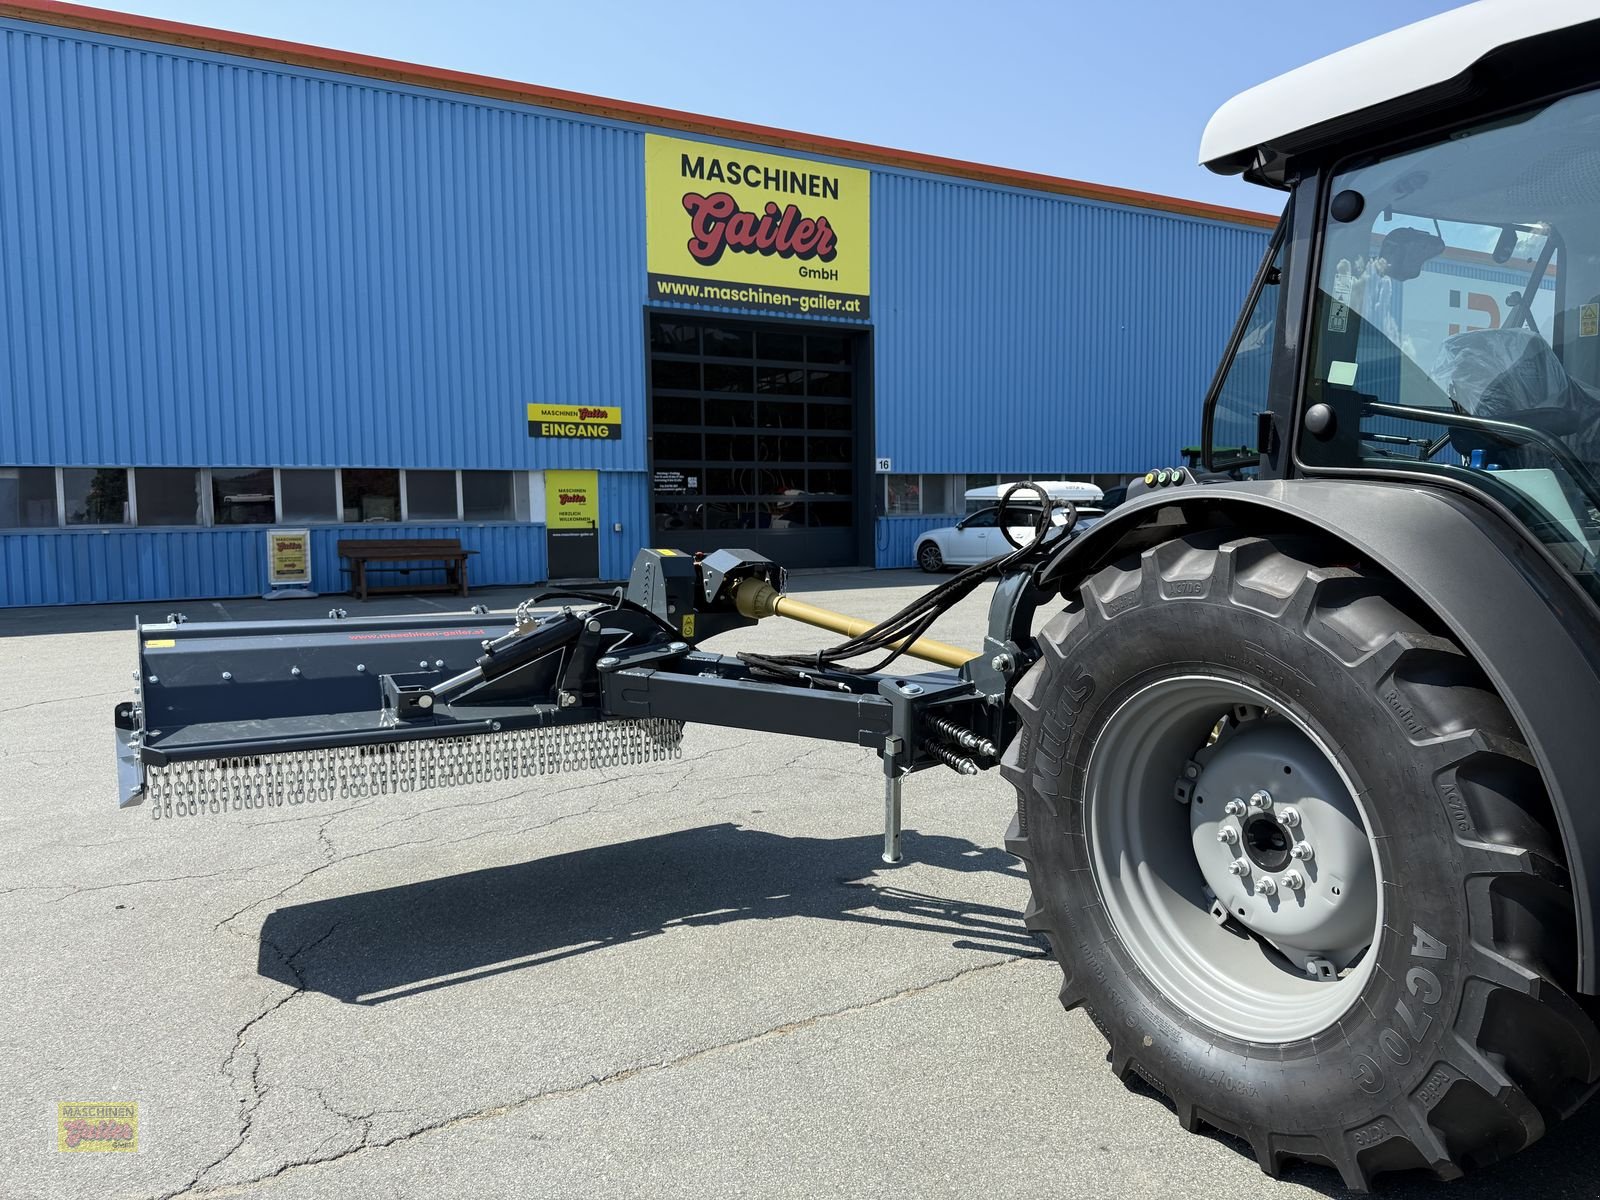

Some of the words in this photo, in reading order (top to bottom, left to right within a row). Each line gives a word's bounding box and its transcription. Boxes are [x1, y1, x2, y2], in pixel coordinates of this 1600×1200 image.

[681, 153, 839, 200] MASCHINEN
[681, 191, 838, 267] Gailer
[798, 266, 839, 281] GmbH
[656, 280, 861, 313] www.maschinen-gailer.at
[541, 409, 578, 417] MASCHINEN
[541, 423, 609, 437] EINGANG
[879, 460, 889, 470] 16
[349, 628, 486, 640] www.maschinen-gailer.at
